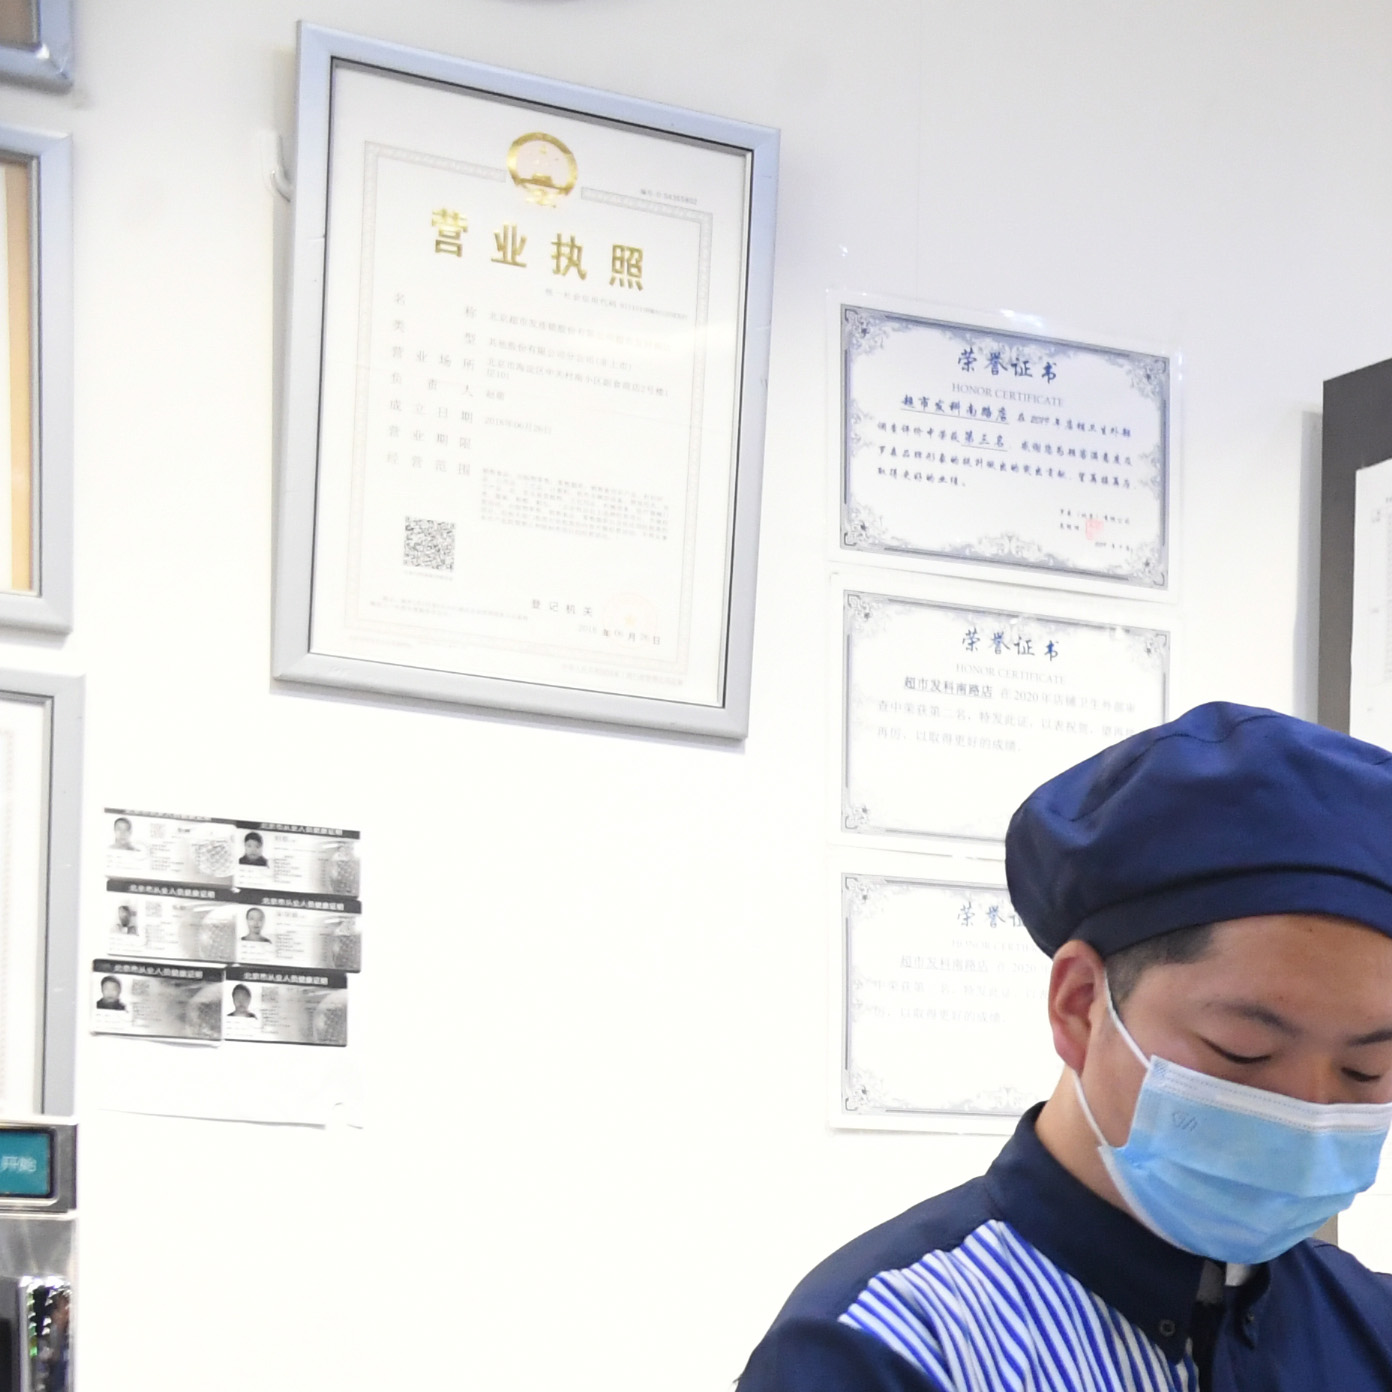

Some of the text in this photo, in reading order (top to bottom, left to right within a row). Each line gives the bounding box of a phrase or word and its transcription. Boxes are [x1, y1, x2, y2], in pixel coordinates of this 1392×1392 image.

[430, 206, 645, 292] 营业执照
[957, 347, 1058, 384] 荣誉证书
[951, 382, 1065, 408] HONOR CERTIFICATE
[961, 626, 1060, 662] 荣誉证书
[955, 663, 1066, 685] HONOR CERTIFICATE
